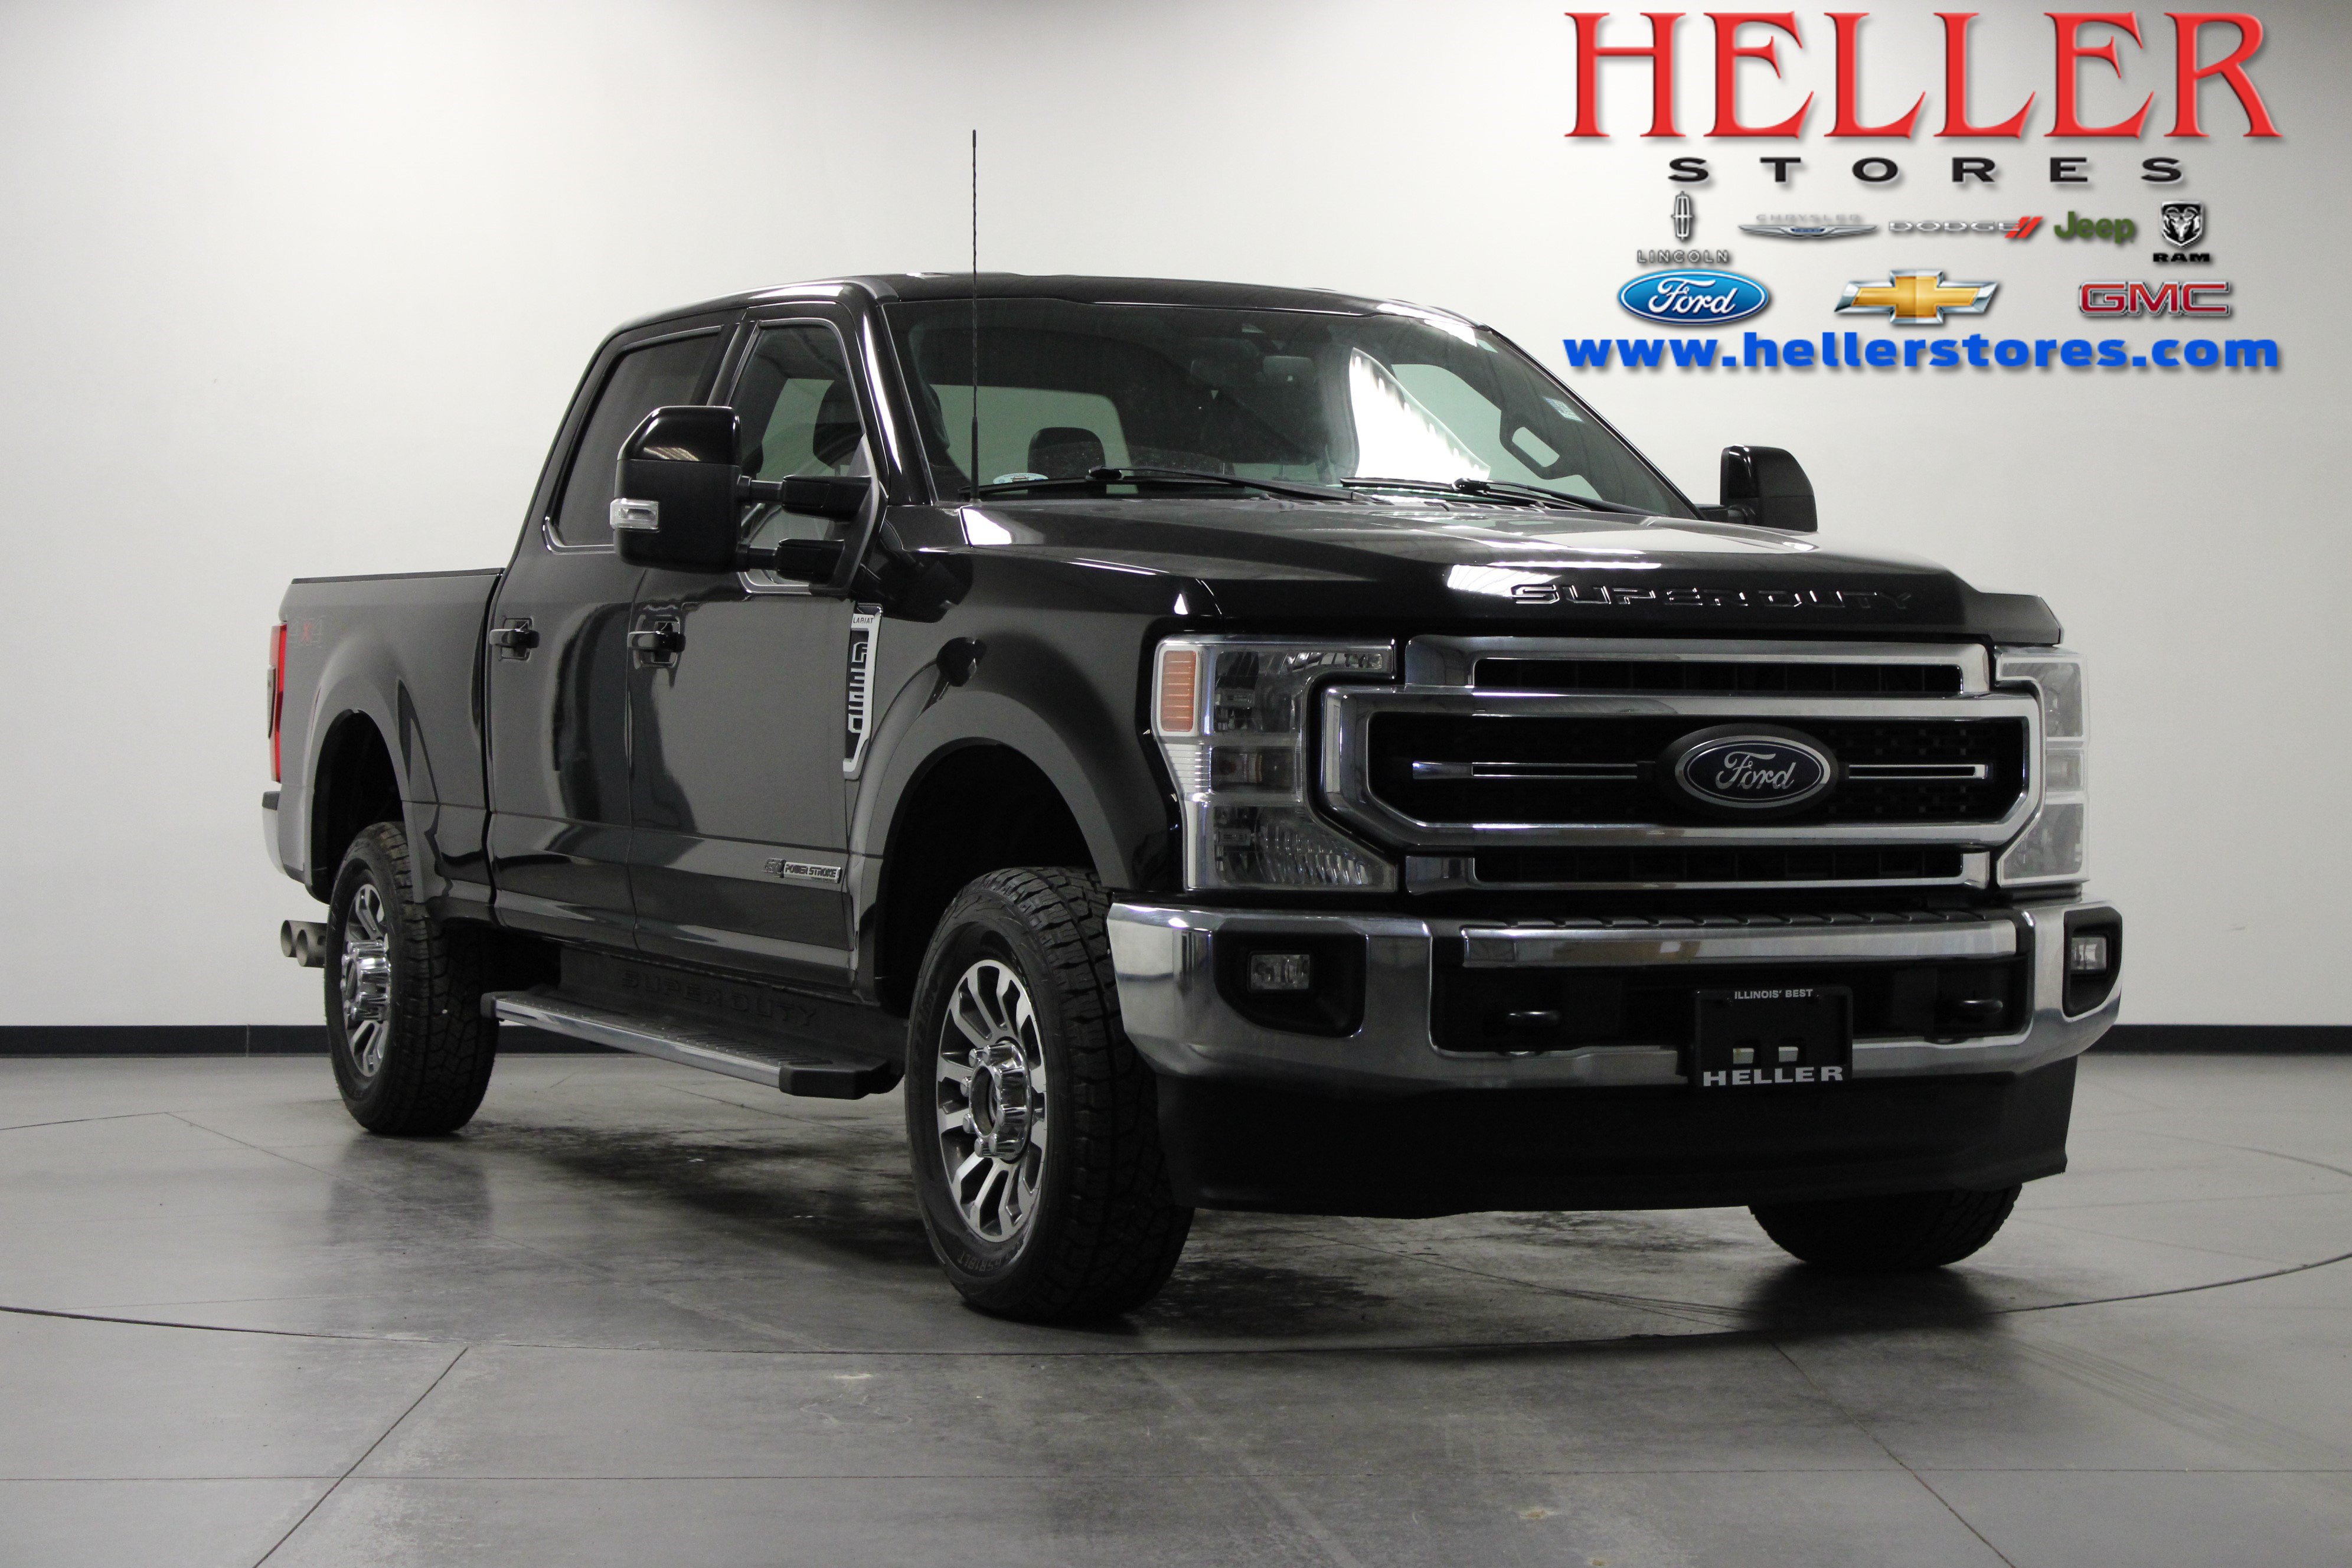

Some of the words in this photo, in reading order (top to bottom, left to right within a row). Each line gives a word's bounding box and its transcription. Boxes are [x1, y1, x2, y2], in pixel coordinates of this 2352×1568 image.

[1510, 584, 1749, 607] SUPER
[1715, 751, 1797, 790] Ford
[785, 864, 808, 875] POWER
[808, 866, 837, 878] STROKE
[1734, 990, 1782, 999] ILLINOIS'
[1785, 989, 1814, 998] BEST
[1703, 1066, 1843, 1087] HELLER
